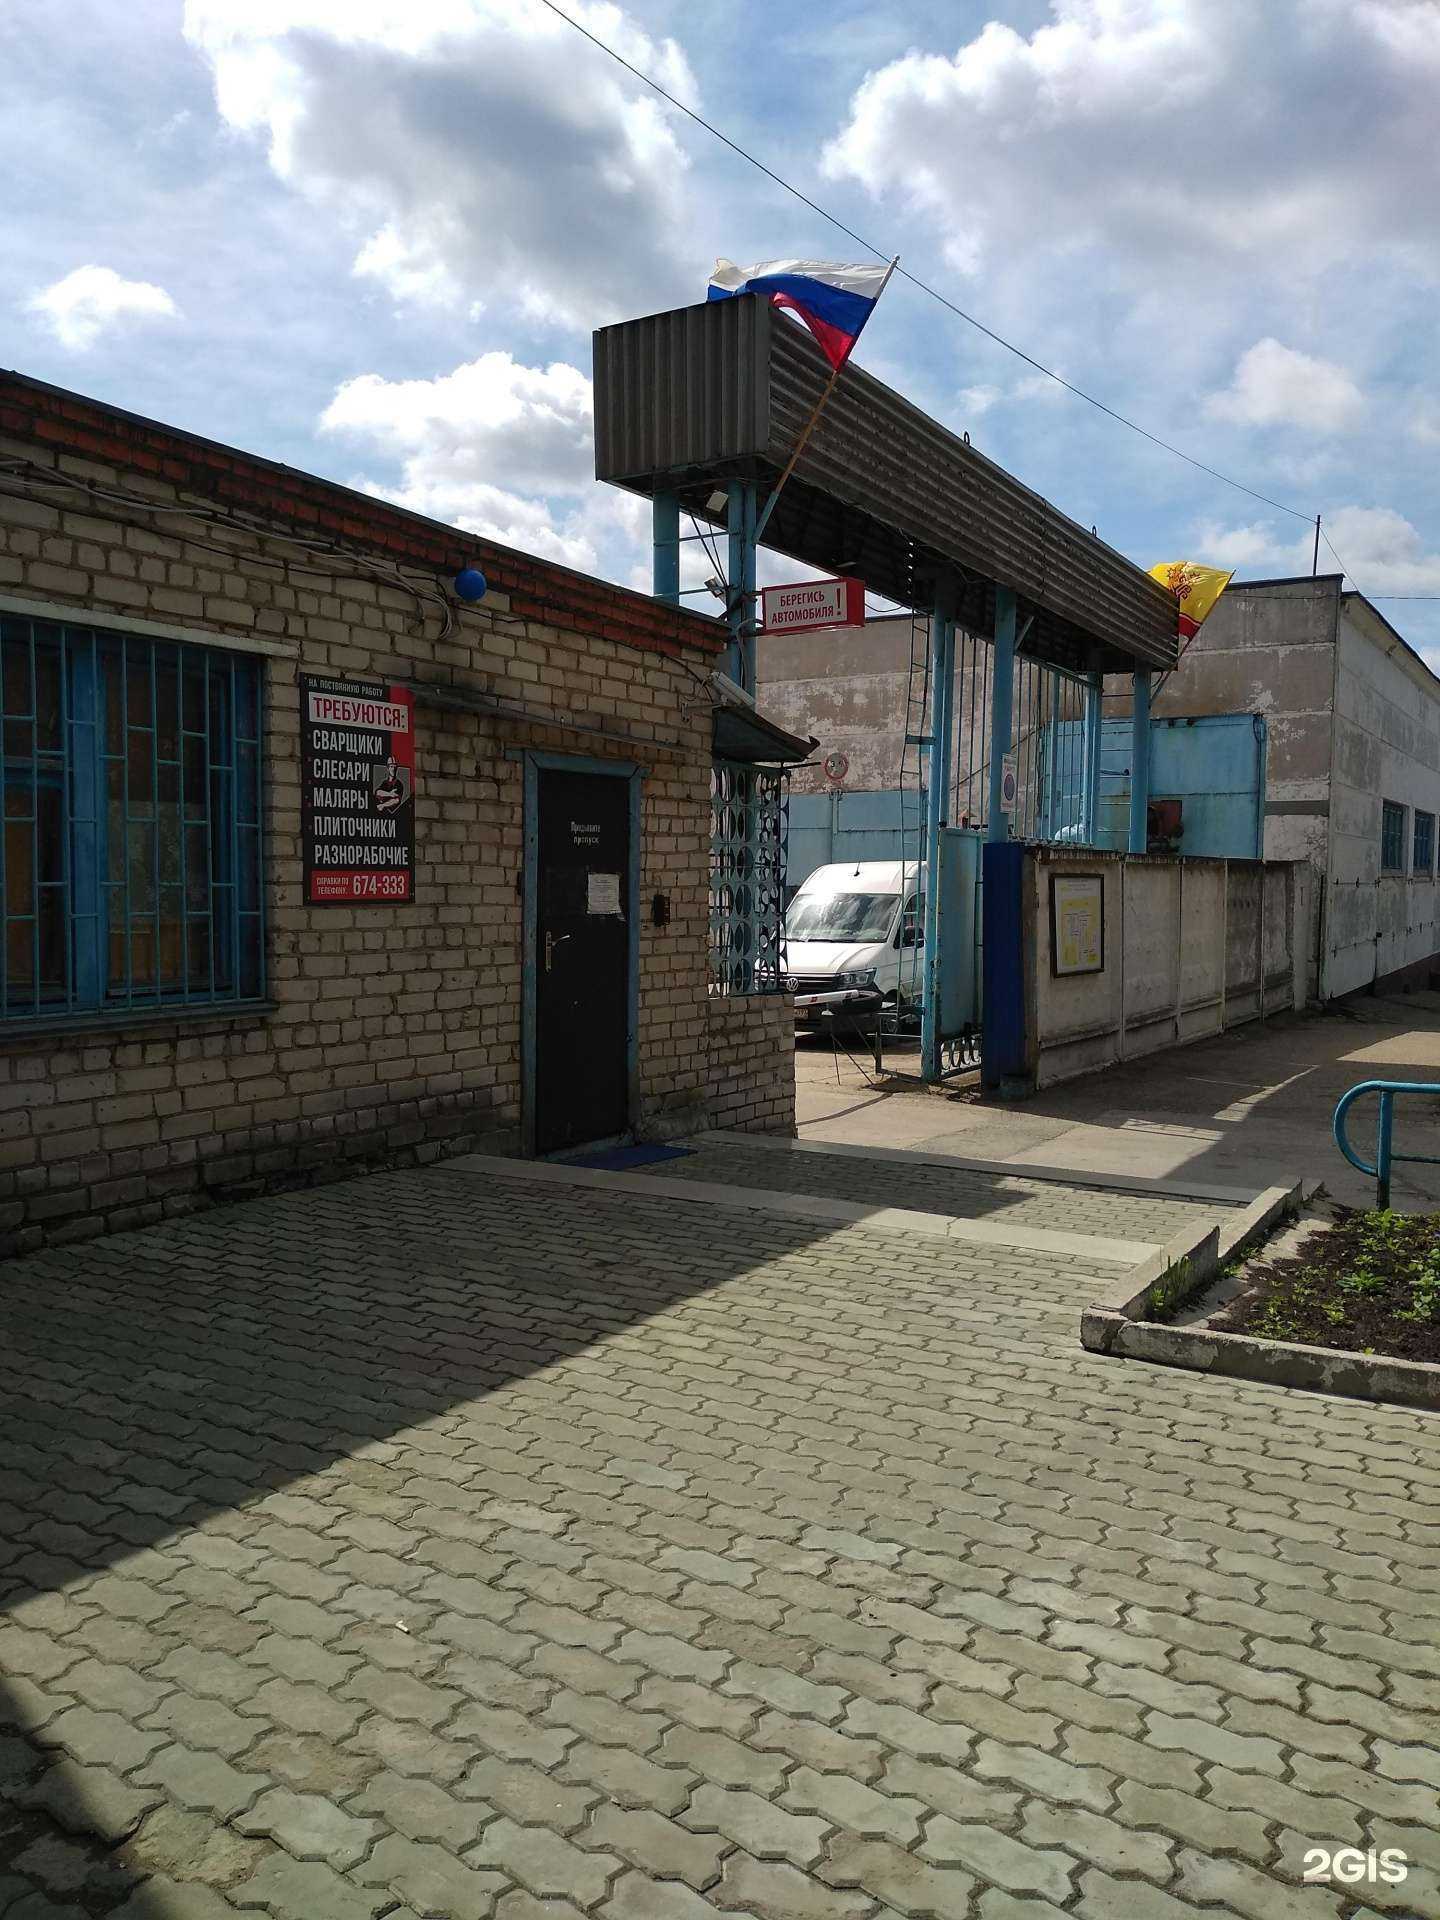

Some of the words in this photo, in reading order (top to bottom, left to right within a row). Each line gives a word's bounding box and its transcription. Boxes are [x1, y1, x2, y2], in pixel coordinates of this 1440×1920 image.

[780, 590, 825, 607] БЕРЕГИСЬ
[308, 677, 318, 688] НА
[320, 679, 360, 694] ПОСТОЯННУЮ
[361, 685, 384, 697] РАБОТУ
[312, 696, 406, 729] ТРЕБУЮТСЯ:
[313, 729, 384, 756] СВАРЩИКИ
[313, 758, 370, 783] СЛЕСАРИ
[313, 787, 369, 810] МАЛЯРЫ
[314, 815, 396, 838] ПЛИТОЧНИКИ
[314, 844, 409, 866] РАЗНОРАБОЧИЕ
[316, 876, 340, 885] СПРАВКИ
[353, 875, 405, 896] 674-333
